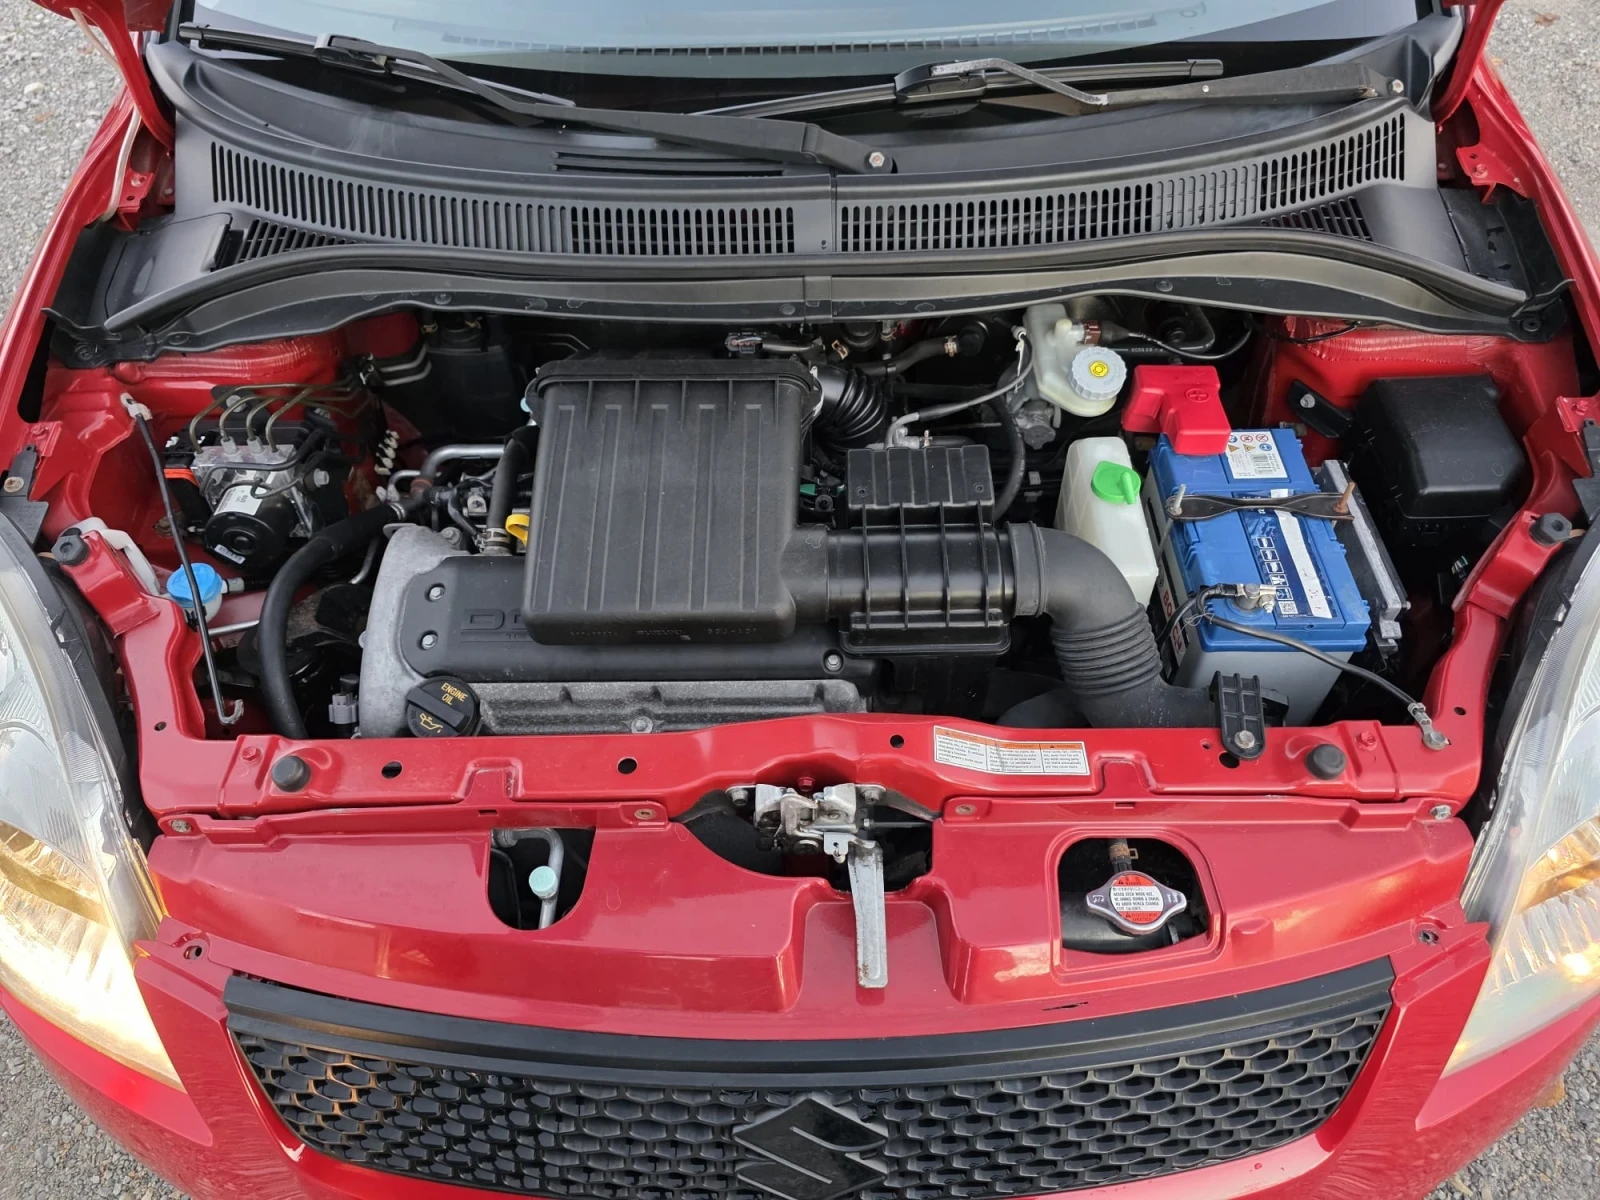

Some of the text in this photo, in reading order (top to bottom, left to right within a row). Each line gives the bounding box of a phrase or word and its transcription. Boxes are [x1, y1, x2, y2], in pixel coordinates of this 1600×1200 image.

[1163, 589, 1183, 654] BOCH
[441, 682, 469, 702] ENGINE
[441, 693, 455, 706] OIL
